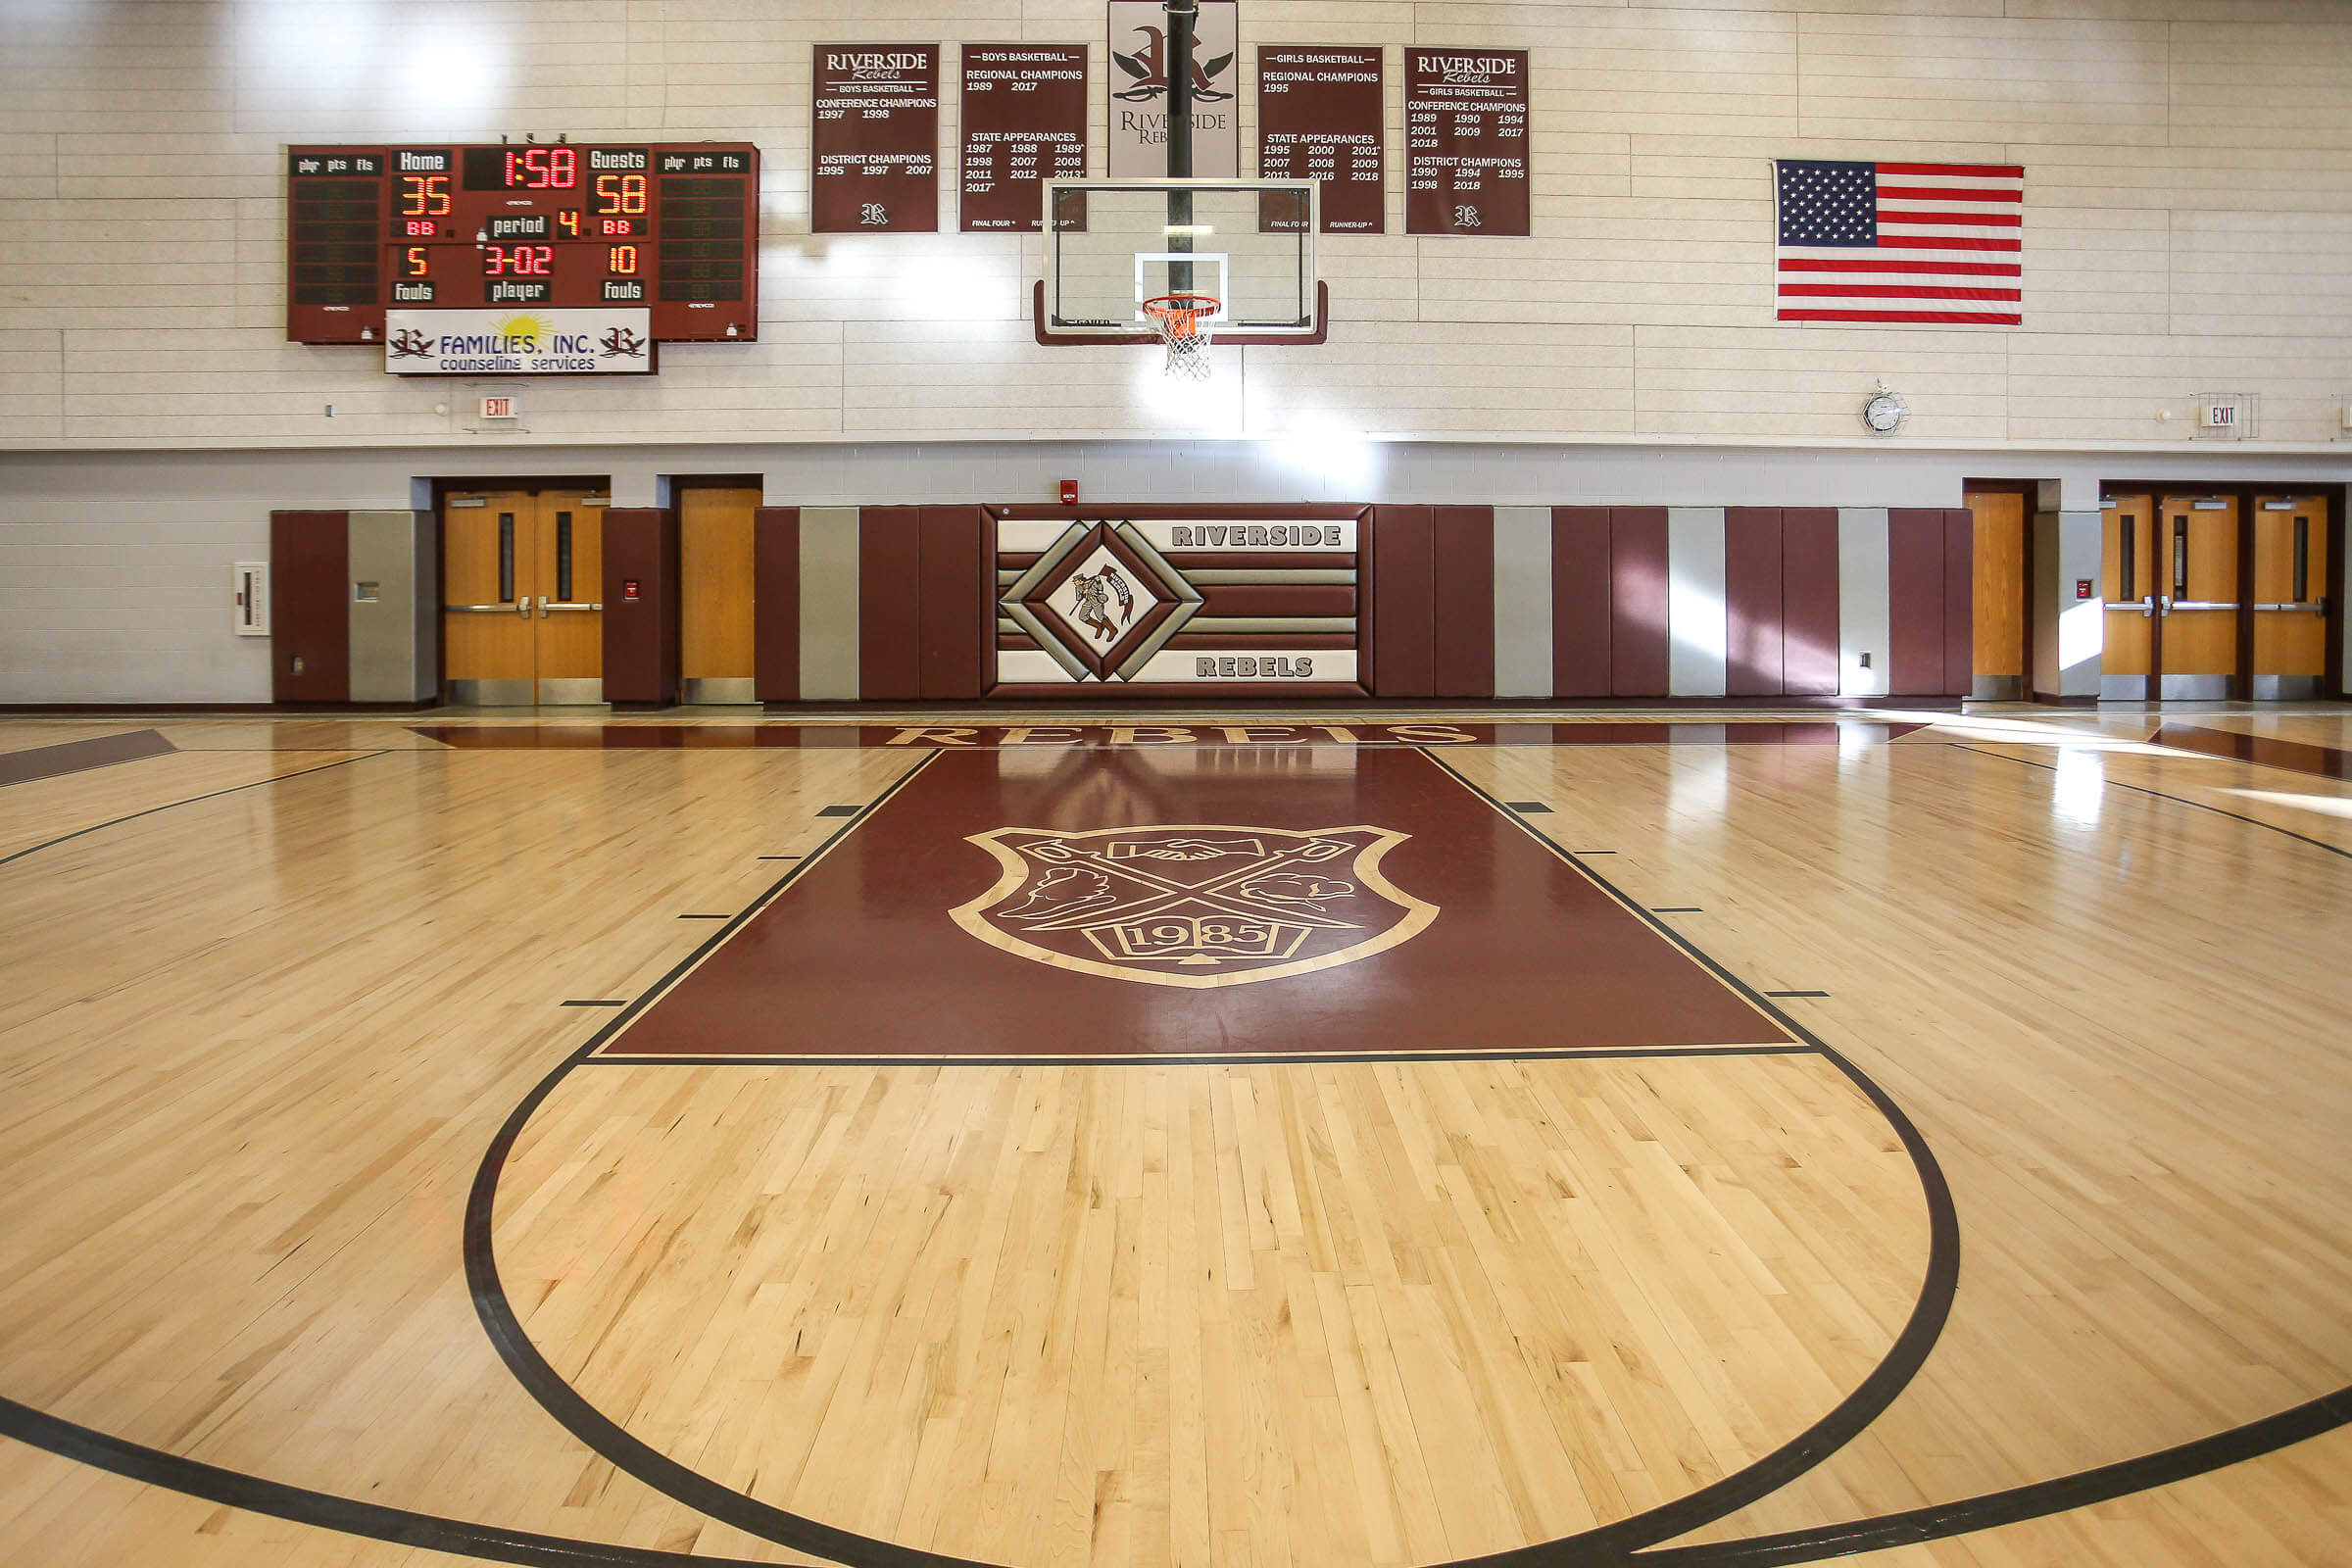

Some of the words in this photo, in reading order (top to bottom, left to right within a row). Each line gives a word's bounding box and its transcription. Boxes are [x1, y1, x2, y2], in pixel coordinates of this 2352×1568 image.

[826, 53, 928, 71] RIVERSIDE
[981, 53, 1007, 62] BOYS
[1008, 53, 1068, 62] BASKETBALL
[1277, 54, 1304, 64] GIRLS
[1306, 55, 1364, 64] BASKETBALL
[1417, 56, 1516, 74] RIVERSIDE
[852, 67, 902, 80] Rebels
[966, 70, 1018, 79] REGIONAL
[1020, 70, 1083, 80] CHAMPIONS
[1262, 72, 1314, 81] REGIONAL
[1316, 73, 1379, 82] CHAMPIONS
[1443, 69, 1491, 83] Rebels
[966, 81, 993, 91] 1989
[1010, 81, 1038, 91] 2017
[1263, 83, 1289, 93] 1995
[1430, 87, 1453, 96] GIRLS
[1454, 88, 1504, 97] BASKETBALL
[815, 99, 879, 108] CONFERENCE
[879, 98, 937, 108] CHAMPIONS
[1408, 101, 1469, 111] CONFERENCE
[1470, 102, 1526, 113] CHAMPIONS
[817, 110, 845, 120] 1997
[862, 110, 890, 120] 1998
[1411, 113, 1437, 122] 1989
[1454, 114, 1481, 123] 1990
[1497, 115, 1524, 124] 1994
[971, 132, 1003, 142] STATE
[1003, 132, 1077, 142] APPEARANCES
[1411, 125, 1437, 135] 2001
[1453, 126, 1481, 136] 2009
[1497, 127, 1524, 137] 2017
[1267, 133, 1298, 143] STATE
[1299, 134, 1375, 144] APPEARANCES
[1411, 138, 1439, 148] 2018
[965, 144, 993, 153] 1987
[1010, 144, 1038, 153] 1988
[1263, 145, 1291, 155] 1995
[1308, 145, 1335, 155] 2000
[327, 159, 347, 172] pts
[356, 158, 373, 171] fls
[400, 152, 444, 171] Home
[590, 150, 646, 170] Guests
[693, 156, 713, 170] pts
[722, 157, 740, 169] fls
[820, 155, 867, 165] DISTRICT
[868, 155, 931, 165] CHAMPIONS
[965, 157, 993, 167] 1998
[1010, 157, 1038, 167] 2007
[1054, 157, 1082, 167] 2008
[1263, 159, 1291, 168] 2007
[1308, 159, 1335, 168] 2008
[1351, 159, 1378, 169] 2009
[1413, 156, 1458, 167] DISTRICT
[1460, 157, 1521, 168] CHAMPIONS
[504, 149, 577, 188] 1:58
[816, 166, 845, 175] 1995
[862, 166, 889, 175] 1997
[906, 166, 933, 175] 2007
[965, 170, 993, 179] 2011
[1009, 170, 1038, 179] 2012
[1411, 168, 1438, 176] 1990
[1454, 168, 1481, 177] 1994
[1497, 169, 1525, 178] 1995
[1308, 172, 1335, 181] 2016
[1351, 172, 1379, 181] 2018
[1411, 180, 1438, 189] 1998
[1452, 180, 1481, 190] 2018
[402, 176, 452, 216] 35
[596, 174, 648, 214] 58
[406, 221, 436, 235] BB
[493, 217, 545, 237] period
[559, 211, 580, 235] 4
[603, 220, 632, 235] BB
[408, 247, 429, 275] 5
[485, 246, 554, 275] 3-02
[610, 245, 638, 273] 10
[395, 282, 432, 300] fouls
[493, 280, 545, 302] player
[605, 281, 642, 298] fouls
[553, 334, 596, 354] INC.
[441, 355, 521, 370] counseling
[531, 356, 596, 370] services
[486, 398, 510, 416] EXIT
[2212, 407, 2234, 424] EXIT
[1172, 525, 1342, 546] RIVERSIDE
[1196, 657, 1313, 677] REBELS
[885, 725, 1478, 745] REBELS
